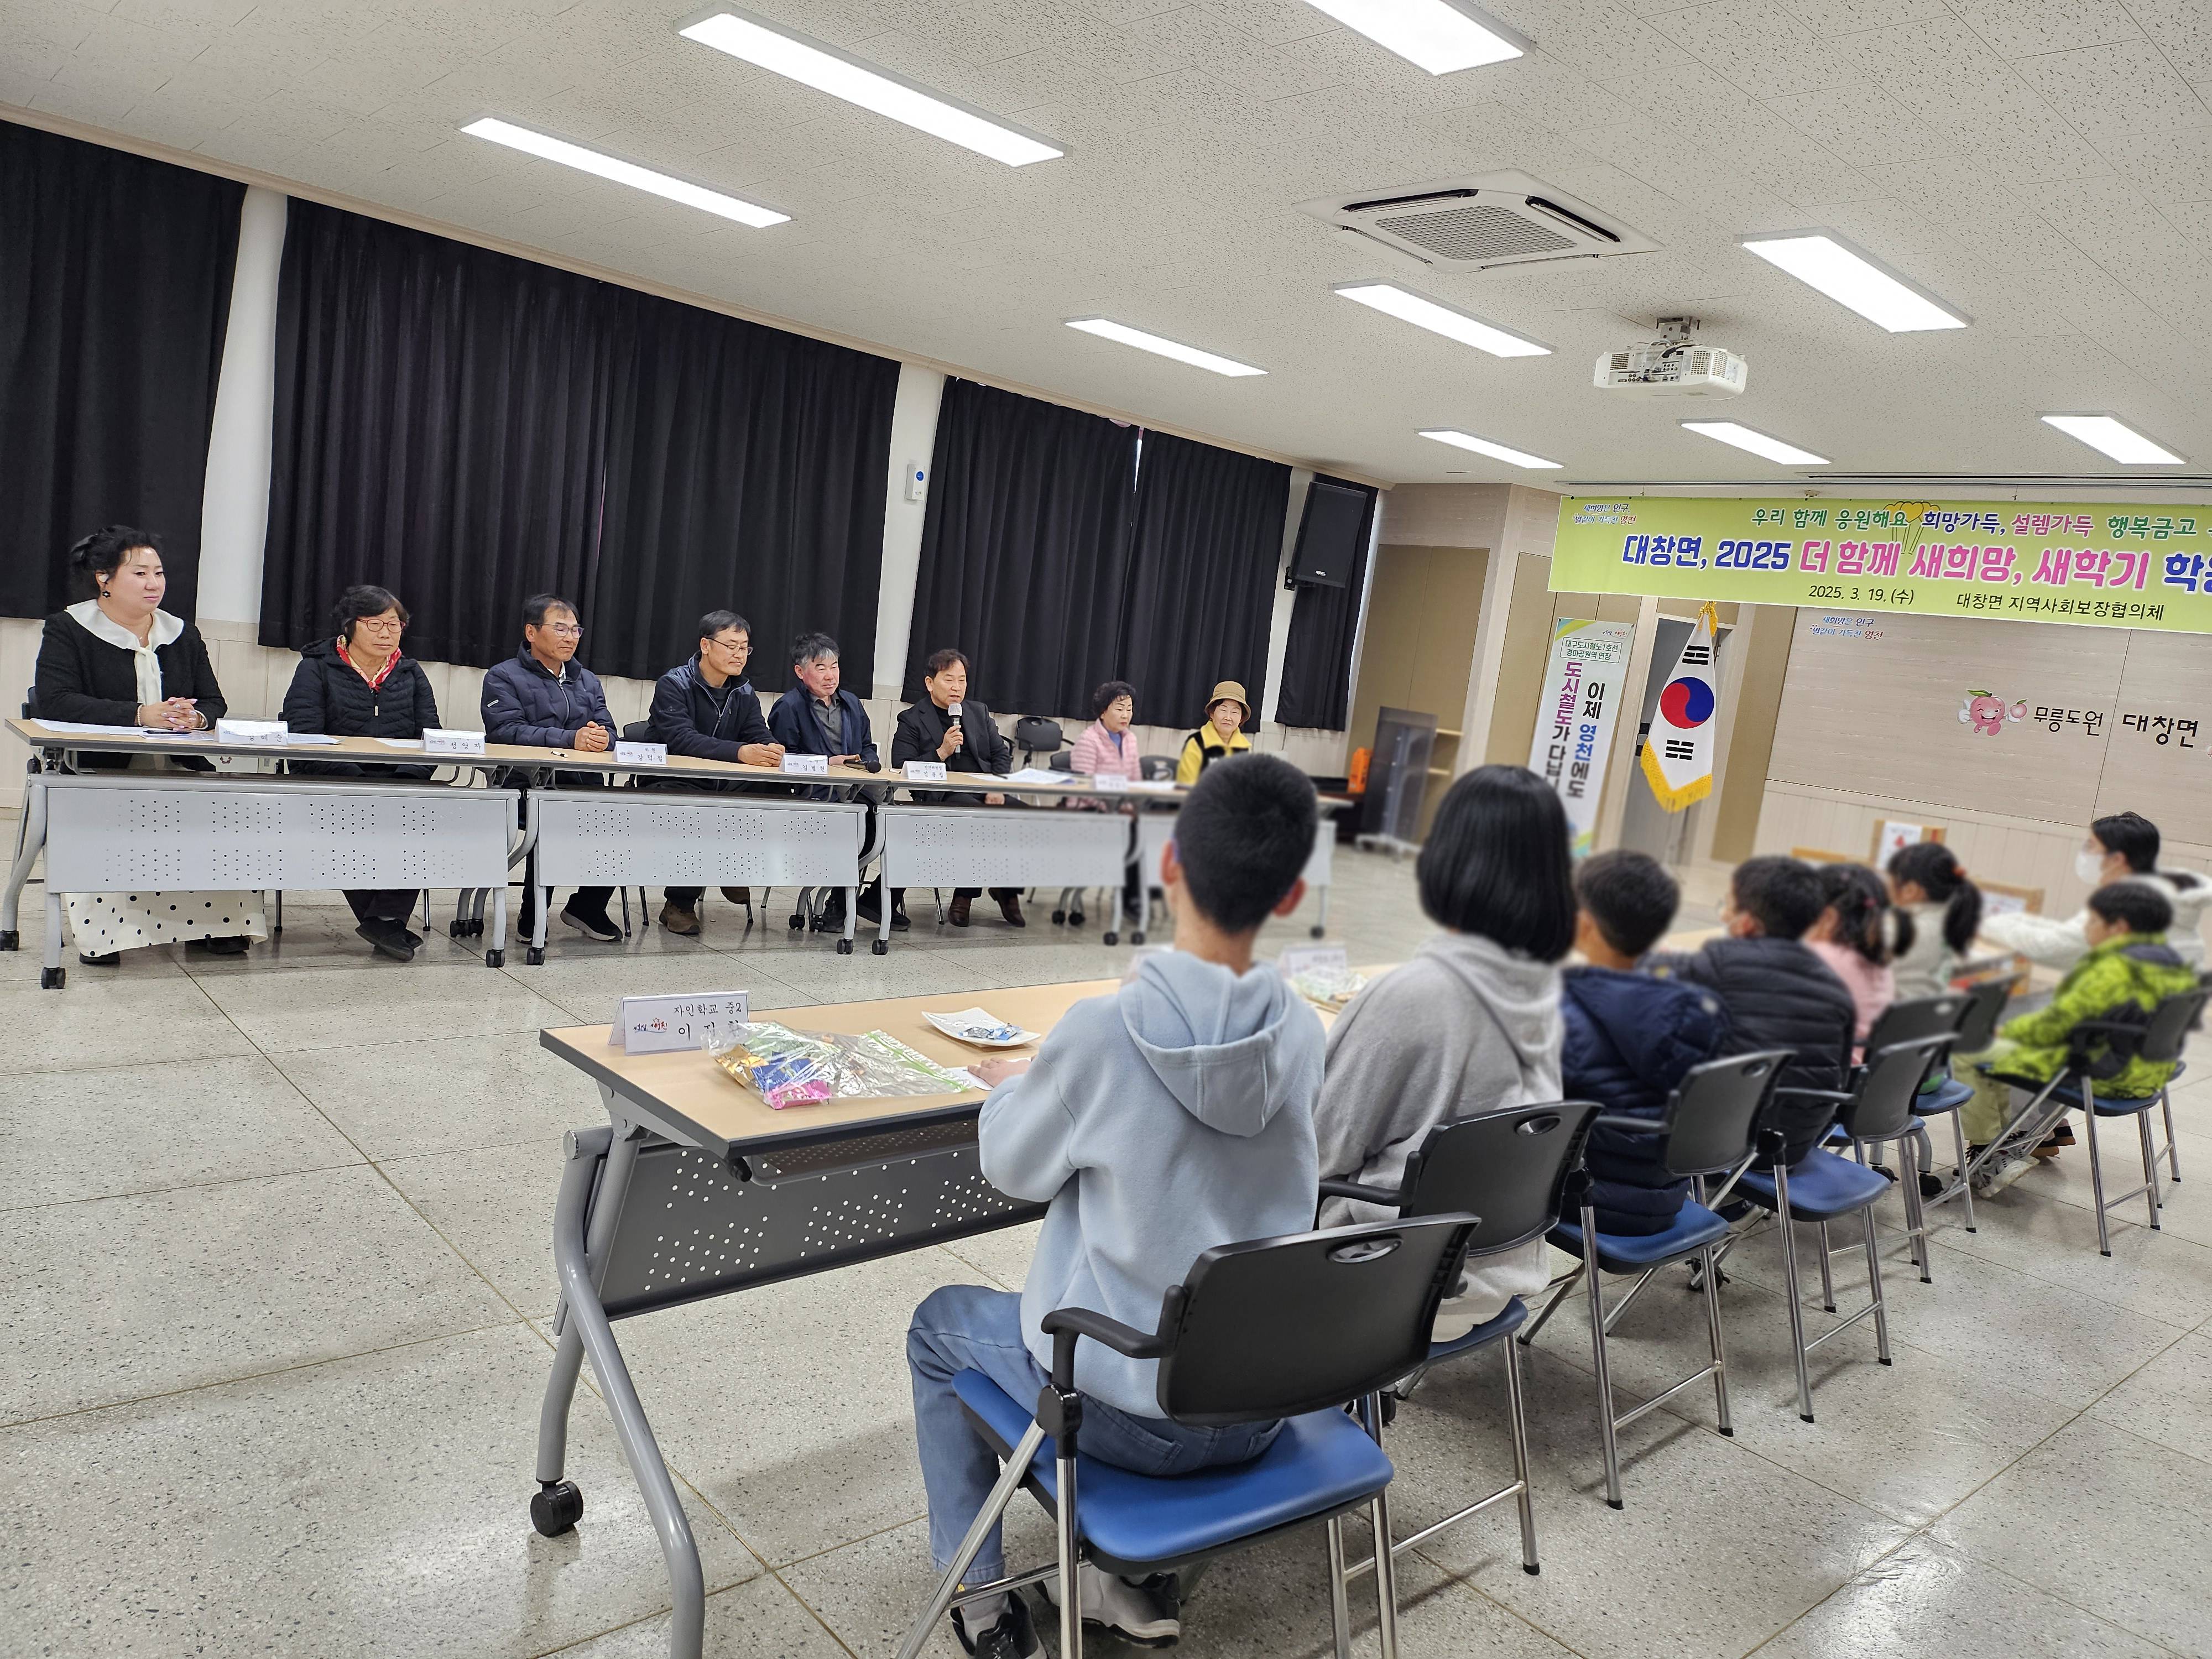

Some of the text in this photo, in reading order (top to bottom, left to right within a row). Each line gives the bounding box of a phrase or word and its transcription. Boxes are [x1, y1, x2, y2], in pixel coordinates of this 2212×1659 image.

[1620, 515, 1637, 525] 영천
[1752, 509, 1785, 527] 우리
[1793, 509, 1828, 529] 함께
[1835, 509, 1908, 530] 응원해요
[1922, 511, 2005, 535] 희망가득,
[2011, 514, 2094, 538] 설렘가득
[2107, 515, 2197, 539] 행복금고
[1623, 535, 1707, 570] 대창면,
[1715, 540, 1791, 570] 2025
[1799, 541, 1830, 573] 더
[1837, 541, 1901, 576] 함께
[1908, 544, 2022, 586] 새희망,
[2032, 549, 2150, 589] 새학기
[1808, 585, 1914, 606] 2025. 3. 19. (수)
[1957, 593, 2164, 621] 대창면 지역사회보장협의체
[1856, 618, 1875, 627] 인구
[1865, 630, 1884, 640] 영천
[1565, 640, 1619, 653] 대구도시철도1호선
[1566, 649, 1611, 661] 경마공원역 연장
[1552, 661, 1583, 742] 도시철도가
[2033, 706, 2199, 749] 무릉도원 대창면
[1567, 682, 1606, 799] 이제 영천에도
[674, 1001, 742, 1018] 자인학교 중2
